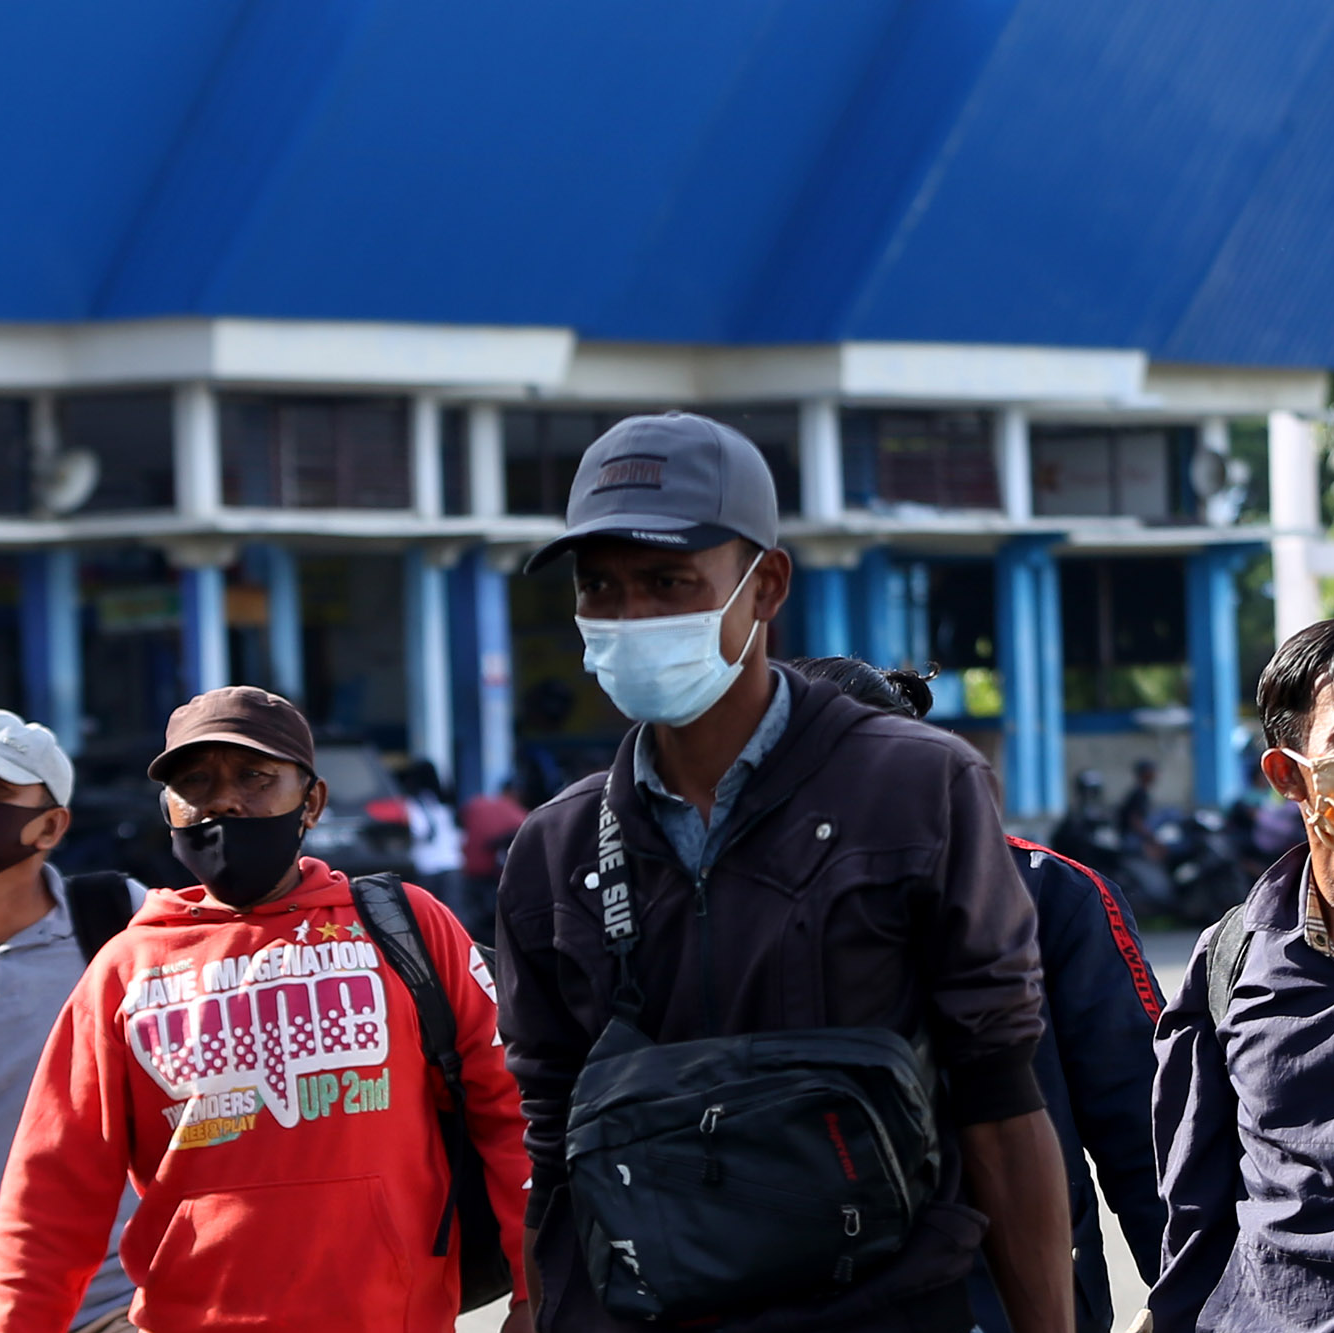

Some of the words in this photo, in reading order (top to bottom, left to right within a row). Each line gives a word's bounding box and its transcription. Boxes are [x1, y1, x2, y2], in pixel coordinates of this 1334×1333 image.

[203, 941, 379, 993] IMAGENATION
[298, 1073, 340, 1121] UP
[341, 1068, 391, 1115] 2nd
[173, 1120, 207, 1145] REE
[225, 1114, 258, 1134] PLAY
